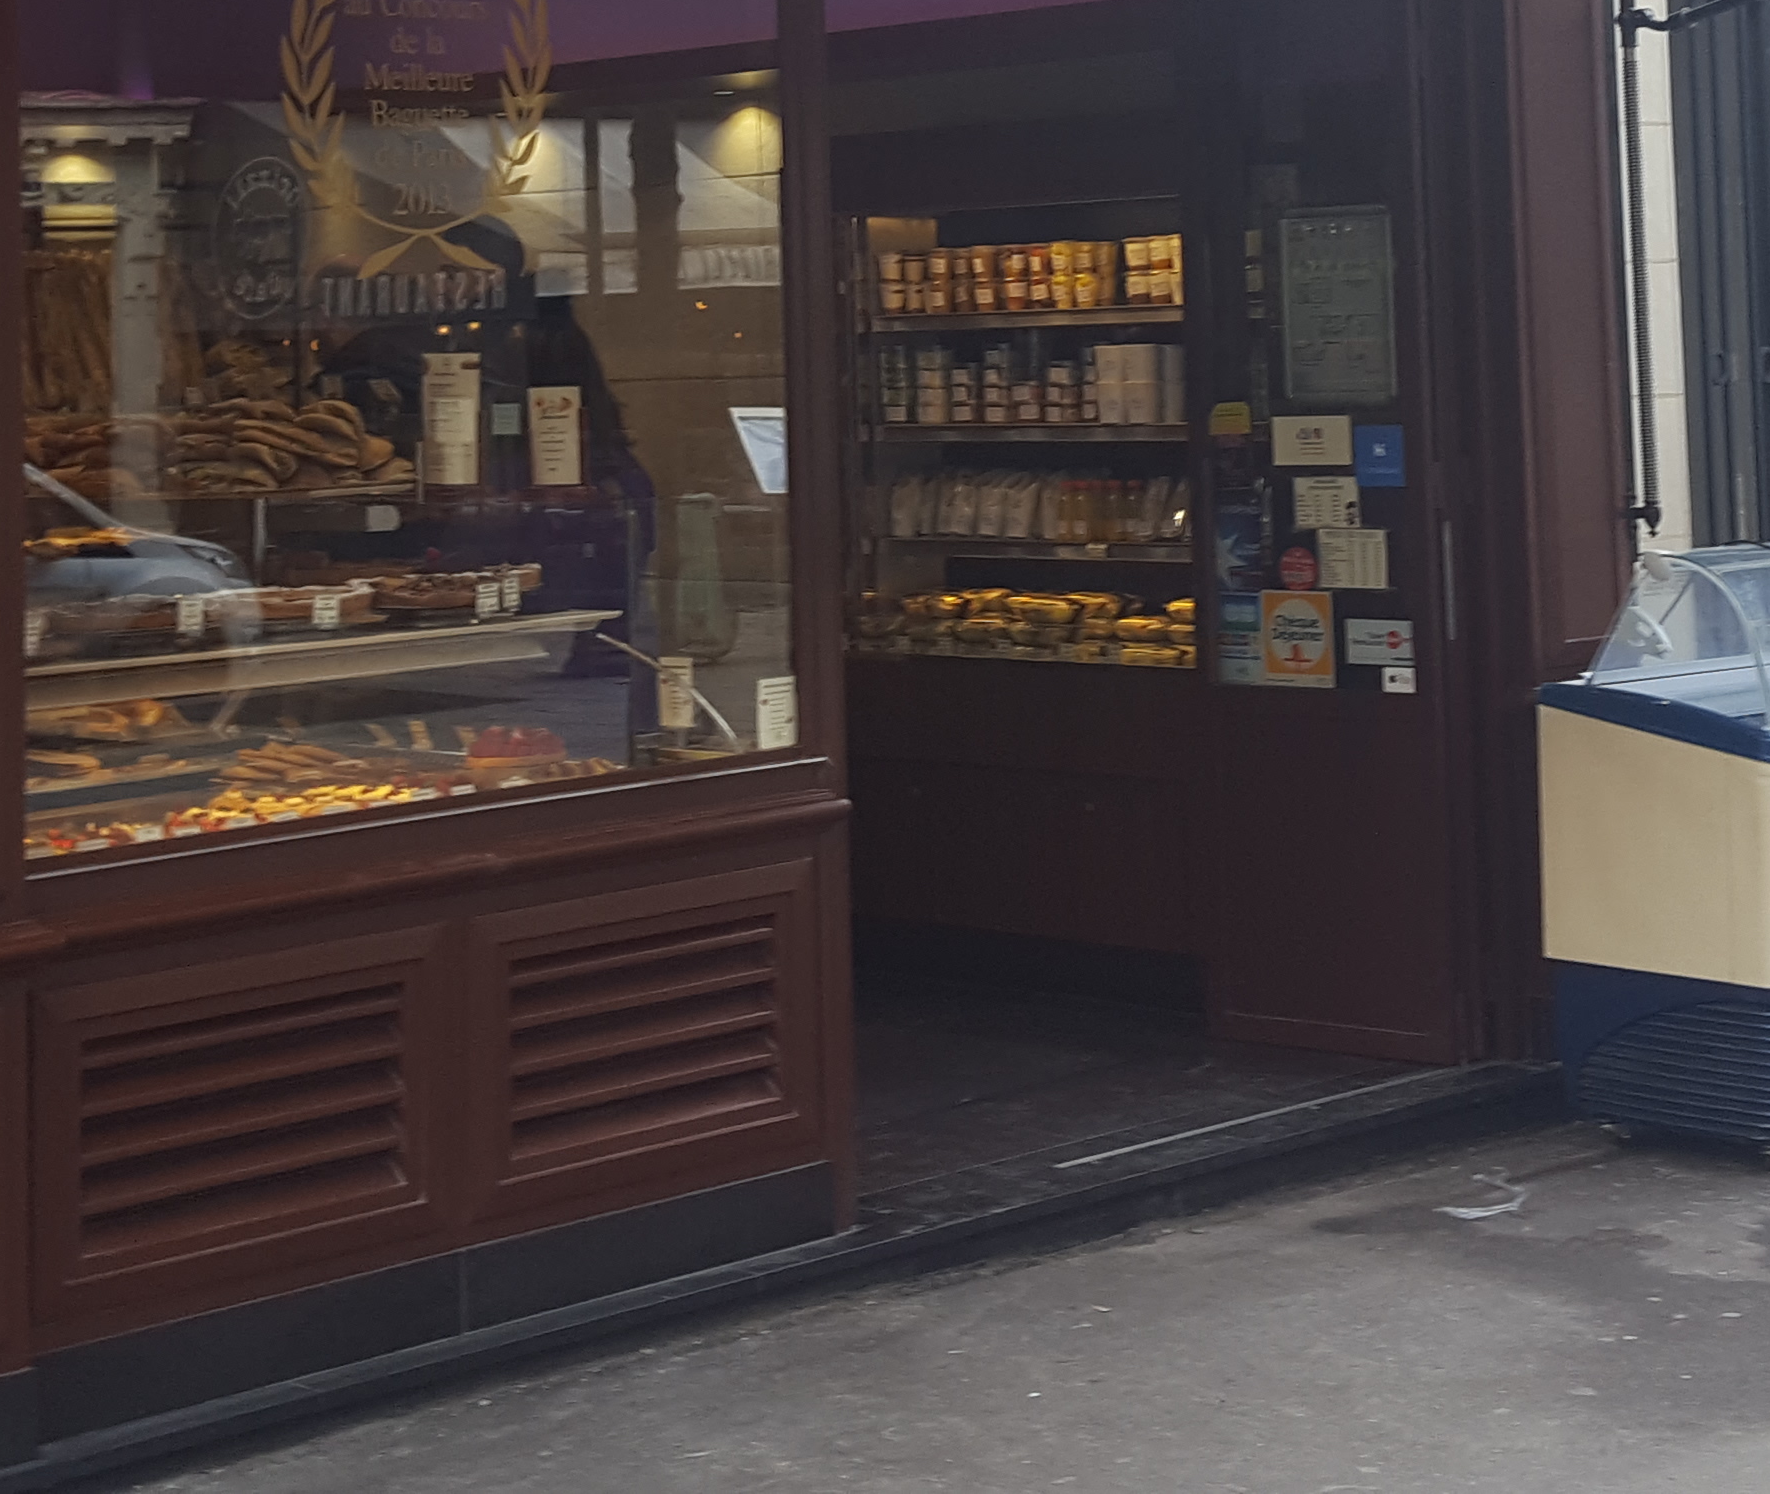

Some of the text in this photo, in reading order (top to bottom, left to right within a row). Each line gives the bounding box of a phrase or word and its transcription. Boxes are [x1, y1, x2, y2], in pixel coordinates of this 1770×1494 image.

[390, 27, 420, 54] de
[364, 63, 475, 92] Meilleure
[369, 98, 471, 134] Baguette
